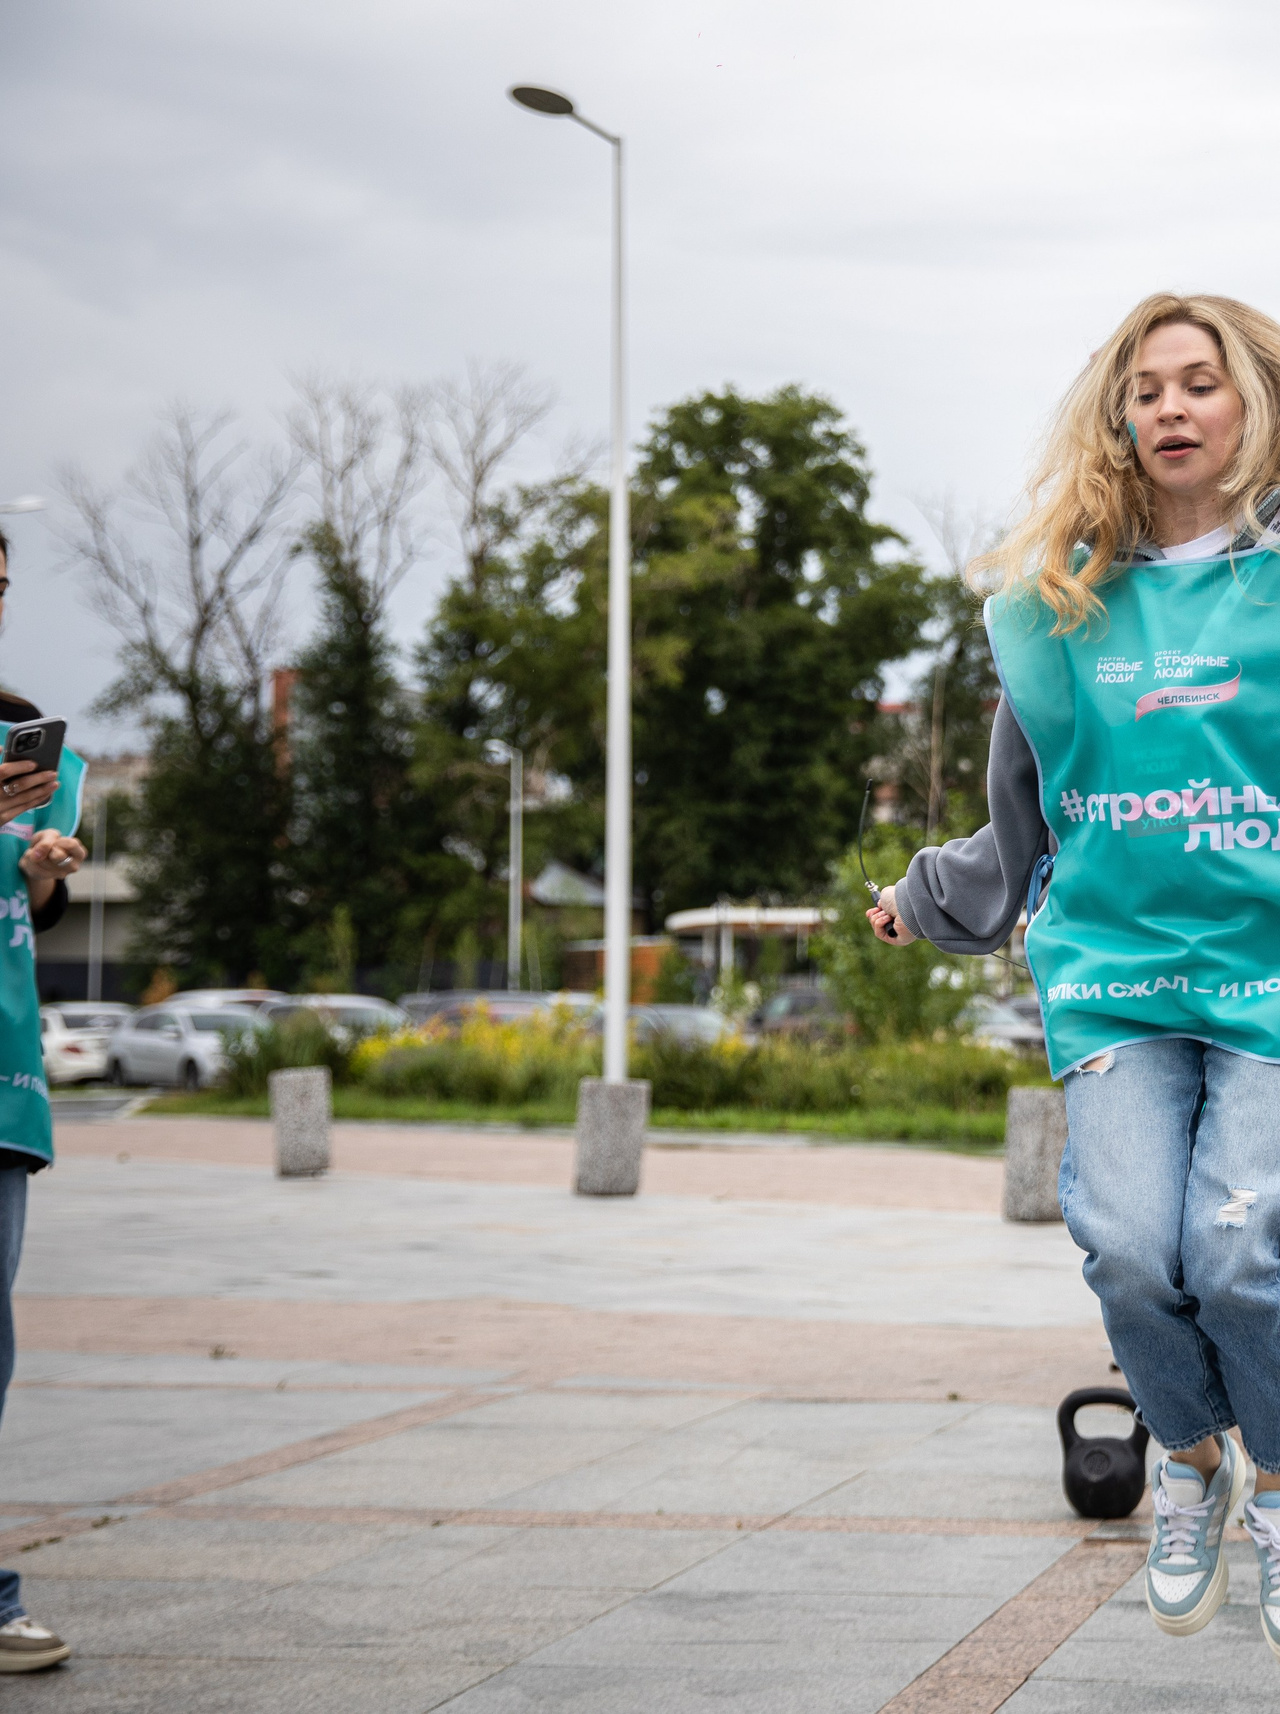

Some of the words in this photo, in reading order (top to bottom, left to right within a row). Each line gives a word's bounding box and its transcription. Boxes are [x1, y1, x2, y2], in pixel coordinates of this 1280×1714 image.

[1096, 660, 1144, 672] НОВЫЕ
[1153, 653, 1230, 668] СТРОЙНЫЕ
[1095, 672, 1135, 684] ЛЮДИ
[1153, 667, 1194, 680] ЛЮДИ
[1157, 692, 1220, 705] ЧЕЛЯБИНСК
[1107, 974, 1189, 999] СЖАЛ
[1218, 982, 1239, 998] И
